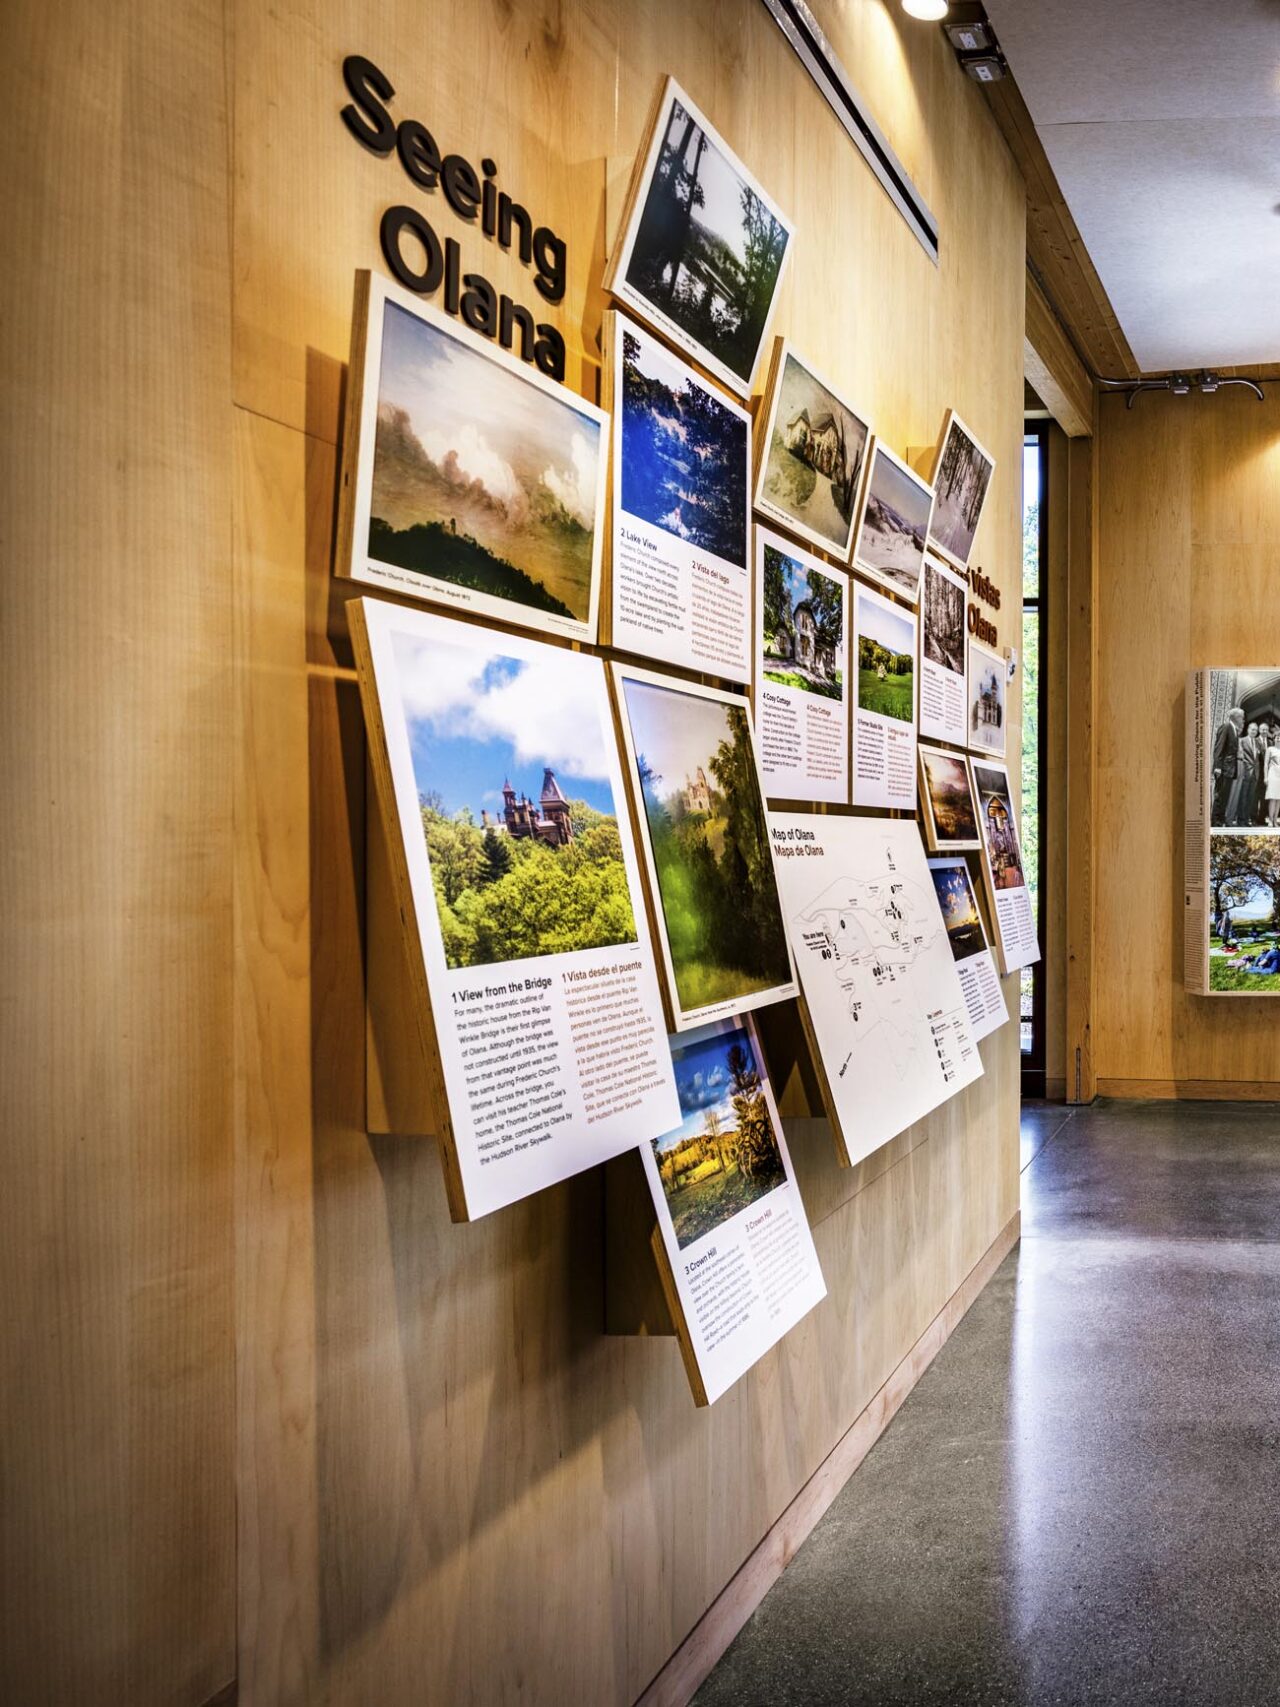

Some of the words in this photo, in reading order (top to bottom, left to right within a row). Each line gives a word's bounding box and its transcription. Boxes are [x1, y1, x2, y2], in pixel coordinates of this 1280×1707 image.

[340, 55, 567, 302] Seeing
[380, 205, 566, 382] Olana
[620, 528, 625, 538] 2
[626, 531, 641, 545] Lake
[642, 537, 658, 552] View
[692, 560, 696, 569] 2
[696, 562, 710, 576] Vista
[720, 571, 730, 584] lago
[972, 566, 1000, 610] Vistas
[968, 602, 998, 648] Olana
[771, 828, 786, 843] Map
[787, 829, 794, 840] of
[795, 829, 815, 840] Olana
[774, 844, 794, 860] Mapa
[795, 845, 804, 856] de
[805, 844, 824, 856] Olana
[567, 971, 587, 982] Vista
[588, 966, 610, 978] desde
[619, 961, 642, 974] puente
[452, 992, 456, 1003] 1
[458, 990, 482, 1001] View
[485, 986, 506, 996] from
[508, 982, 522, 992] the
[524, 978, 552, 990] Bridge
[495, 999, 518, 1009] dramatic
[520, 996, 537, 1004] outline
[459, 1035, 479, 1044] Winkle
[480, 1030, 499, 1039] Bridge
[531, 1018, 550, 1028] glimpse
[468, 1019, 489, 1028] historic
[489, 1039, 514, 1050] Although
[525, 1033, 542, 1041] bridge
[466, 1076, 480, 1084] from
[494, 1066, 516, 1076] vantage
[517, 1061, 531, 1070] point
[543, 1054, 557, 1062] much
[475, 1053, 508, 1068] constructed
[510, 1050, 521, 1059] until
[480, 1085, 495, 1094] same
[496, 1080, 514, 1089] during
[515, 1073, 537, 1083] Frederic
[538, 1065, 560, 1076] Church's
[473, 1116, 484, 1124] can
[486, 1112, 497, 1120] visit
[507, 1102, 528, 1113] teacher
[529, 1095, 550, 1105] Thomas
[551, 1089, 566, 1098] Cole's
[496, 1093, 514, 1103] Across
[506, 1116, 528, 1127] Thomas
[528, 1111, 540, 1119] Cole
[542, 1102, 562, 1114] National
[478, 1139, 500, 1150] Historic
[515, 1123, 543, 1138] connected
[550, 1115, 565, 1125] Olana
[491, 1148, 513, 1160] Hudson
[514, 1142, 528, 1151] River
[749, 1214, 764, 1230] Crown
[684, 1266, 690, 1275] 3
[690, 1255, 708, 1272] Crown
[708, 1247, 717, 1260] Hill
